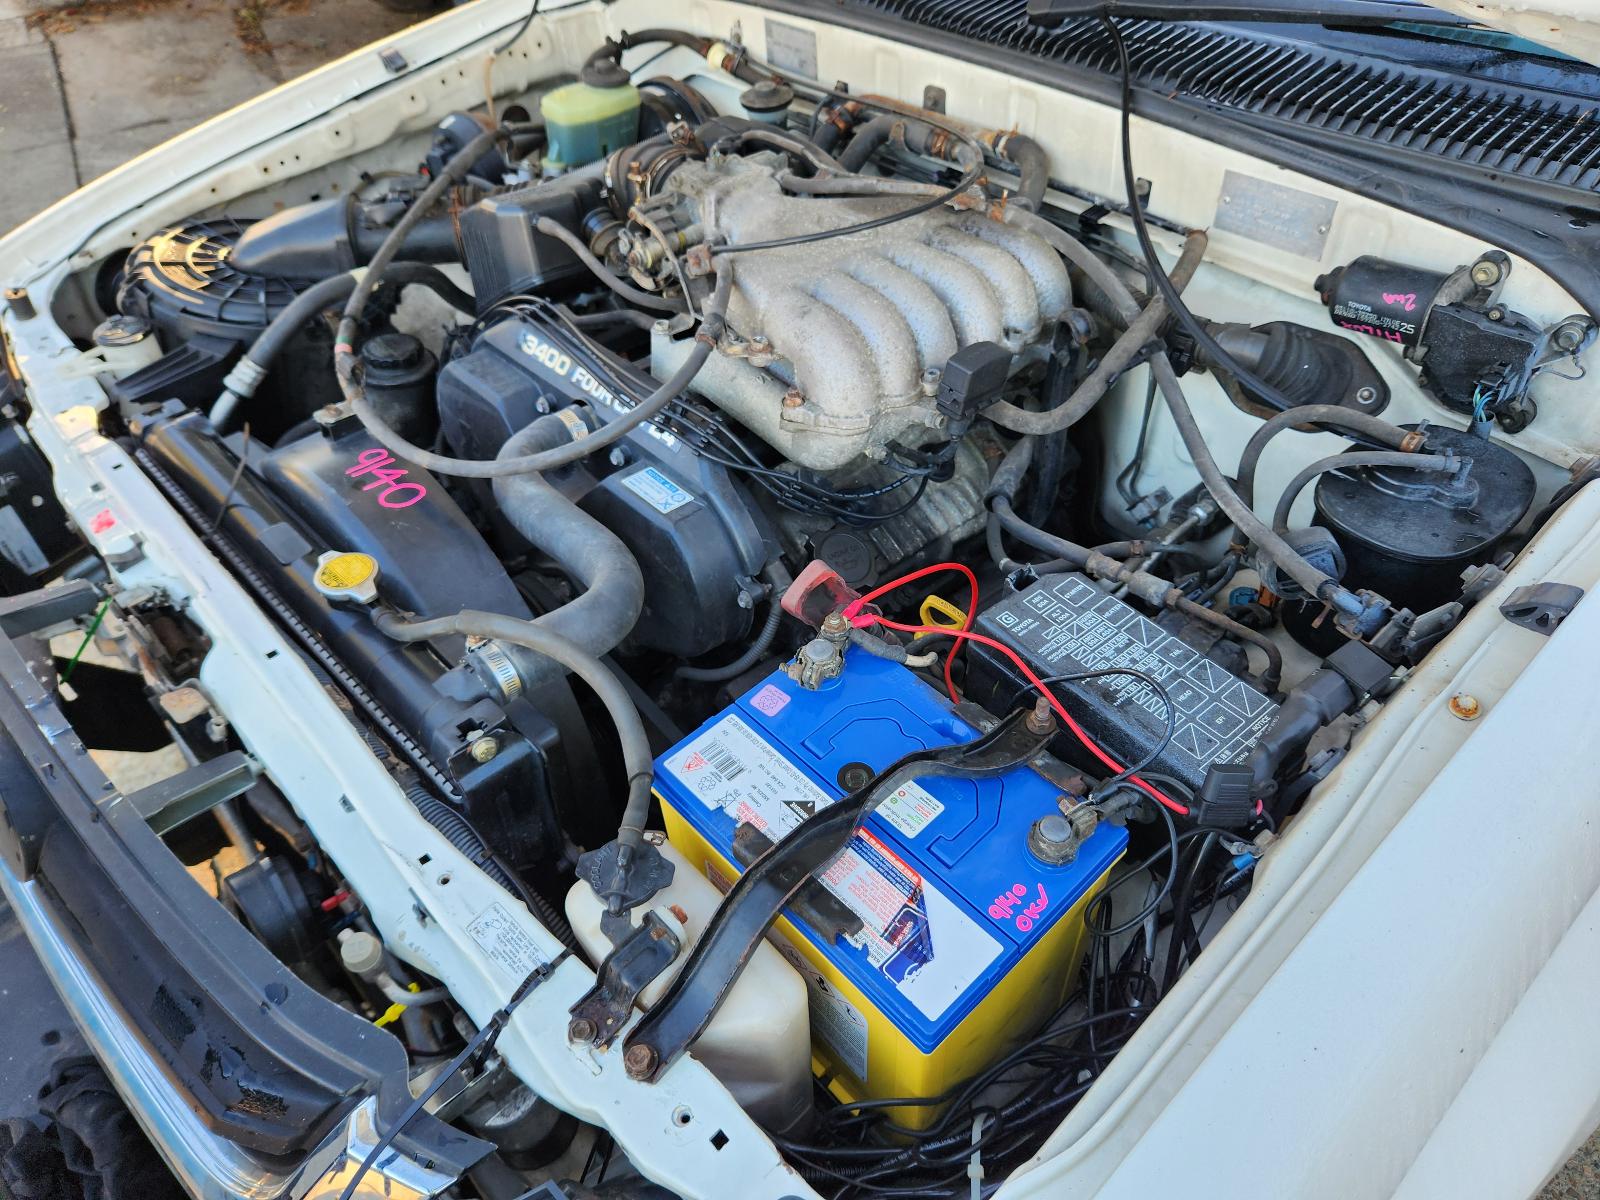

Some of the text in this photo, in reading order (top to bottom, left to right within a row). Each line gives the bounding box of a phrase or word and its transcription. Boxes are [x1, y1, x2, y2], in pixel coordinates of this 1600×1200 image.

[1348, 301, 1372, 312] TOYOTA
[1400, 322, 1416, 334] 25
[521, 334, 572, 376] 3400
[571, 366, 614, 406] FOUR
[344, 448, 426, 508] 9140
[1051, 610, 1062, 618] ALT
[1056, 612, 1070, 622] 100A
[1102, 604, 1125, 618] HEATER
[1011, 618, 1034, 633] TOYOTA
[1056, 635, 1067, 644] 10A
[1177, 690, 1192, 702] HEAD
[1215, 716, 1225, 724] EFI
[1252, 716, 1271, 732] NOTICE
[989, 884, 1026, 919] 9140
